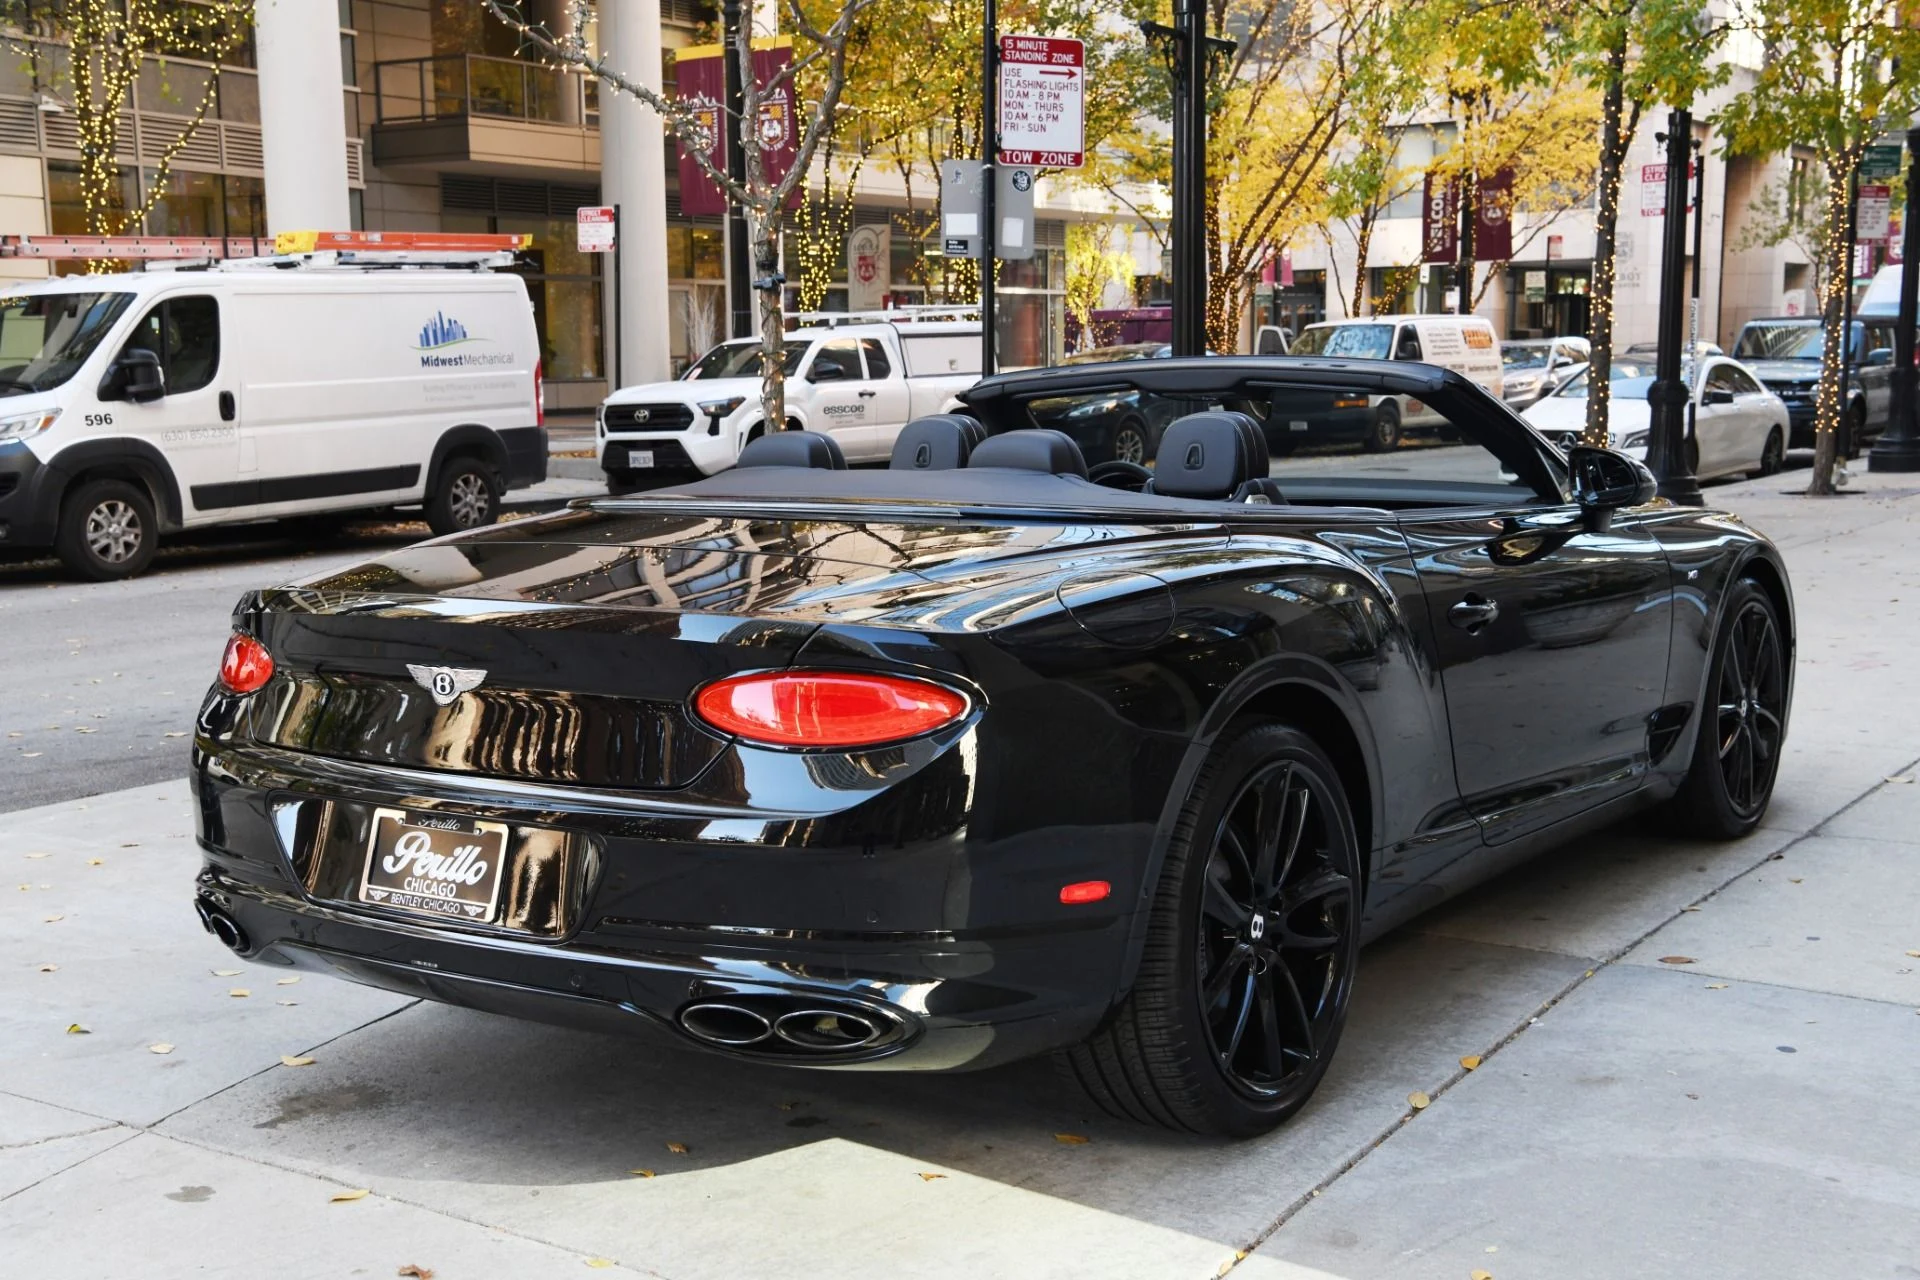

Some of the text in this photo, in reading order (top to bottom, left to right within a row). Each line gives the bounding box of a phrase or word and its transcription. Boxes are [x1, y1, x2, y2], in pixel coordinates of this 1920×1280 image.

[1005, 39, 1049, 51] 15 MINUTE
[1005, 50, 1075, 64] STANDING ZONE
[1005, 68, 1022, 78] USE
[1004, 79, 1079, 92] FLASHING LIGHTS
[1005, 90, 1014, 99] 10
[1016, 90, 1029, 99] AM
[1038, 92, 1044, 101] 8
[1047, 92, 1060, 101] PM
[1004, 100, 1024, 110] MON
[1035, 102, 1064, 112] THURS
[1005, 111, 1013, 120] 10
[1015, 112, 1028, 121] AM
[1038, 113, 1044, 122] 6
[1046, 114, 1059, 123] PM
[1004, 122, 1019, 132] FRI
[1027, 123, 1047, 133] SUN
[1005, 151, 1075, 166] TOW ZONE
[823, 404, 865, 415] esscoe
[84, 413, 113, 427] 596
[418, 816, 461, 831] Perillo
[382, 830, 488, 886] Perillo
[403, 876, 457, 898] CHICAGO
[390, 893, 461, 914] BENTLEY CHICAGO
